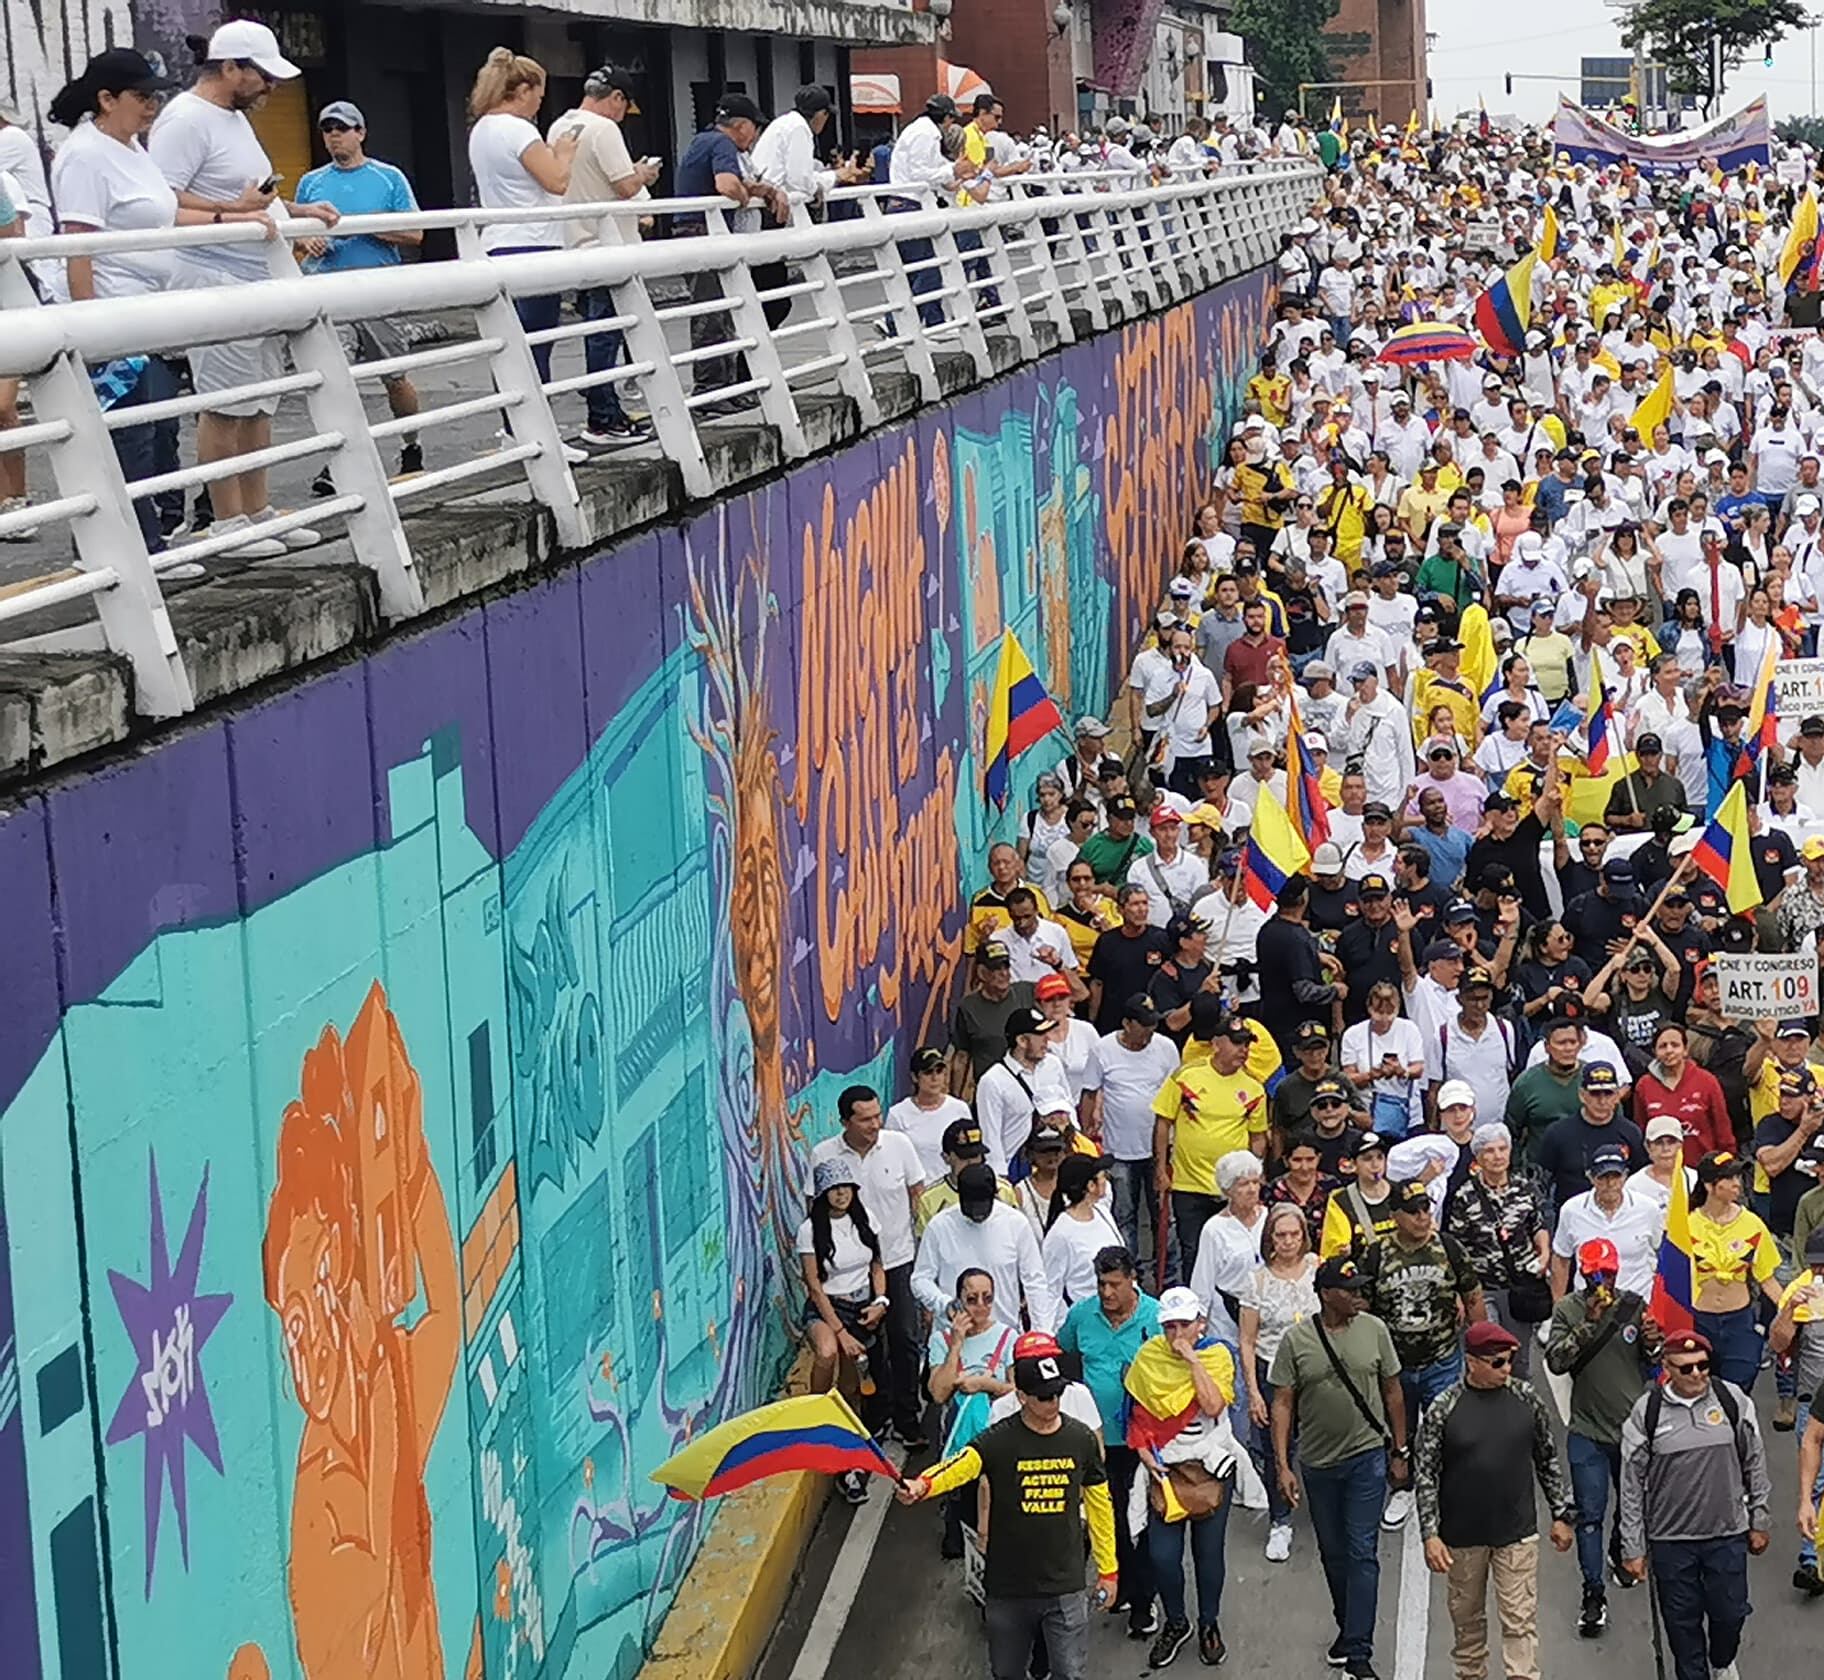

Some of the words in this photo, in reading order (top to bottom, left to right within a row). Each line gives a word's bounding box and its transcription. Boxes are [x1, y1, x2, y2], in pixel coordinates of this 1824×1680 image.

[1782, 681, 1812, 697] ART.
[1720, 959, 1740, 972] CNE
[1744, 960, 1751, 971] Y
[1755, 958, 1815, 972] CONGRESO
[1728, 980, 1767, 1000] ART.
[1771, 975, 1809, 1000] 109
[1802, 999, 1817, 1013] YA
[1017, 1458, 1076, 1472] RESERVA
[1021, 1474, 1070, 1487] ACTIVA
[1021, 1501, 1066, 1513] VALLE
